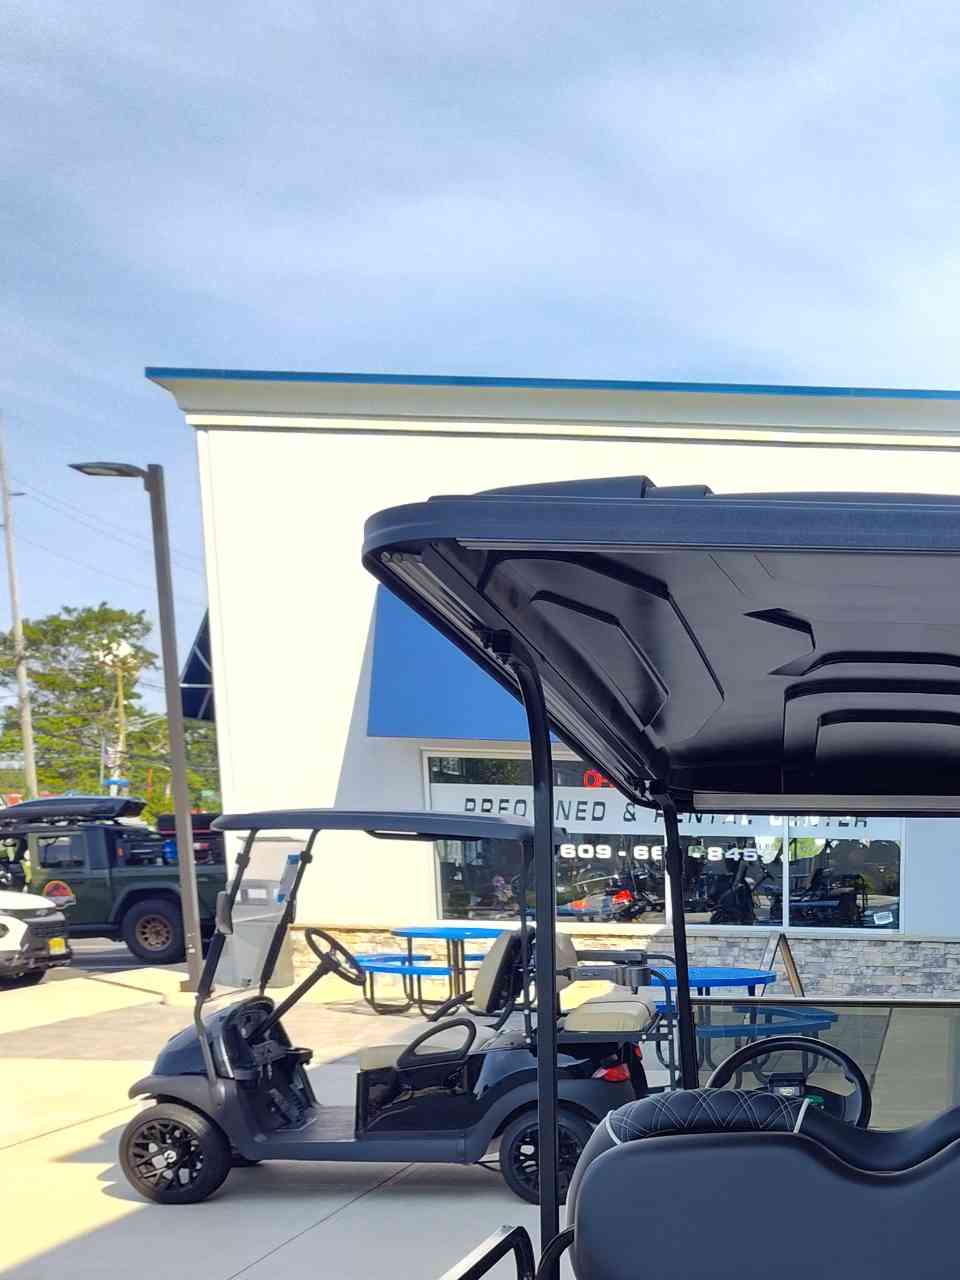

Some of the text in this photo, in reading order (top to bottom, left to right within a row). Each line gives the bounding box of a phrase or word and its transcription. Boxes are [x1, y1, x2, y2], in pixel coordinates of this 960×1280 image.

[464, 797, 606, 821] PREONED
[623, 802, 637, 823] &
[560, 843, 612, 859] 609
[633, 845, 665, 861] 66
[707, 846, 758, 862] 845
